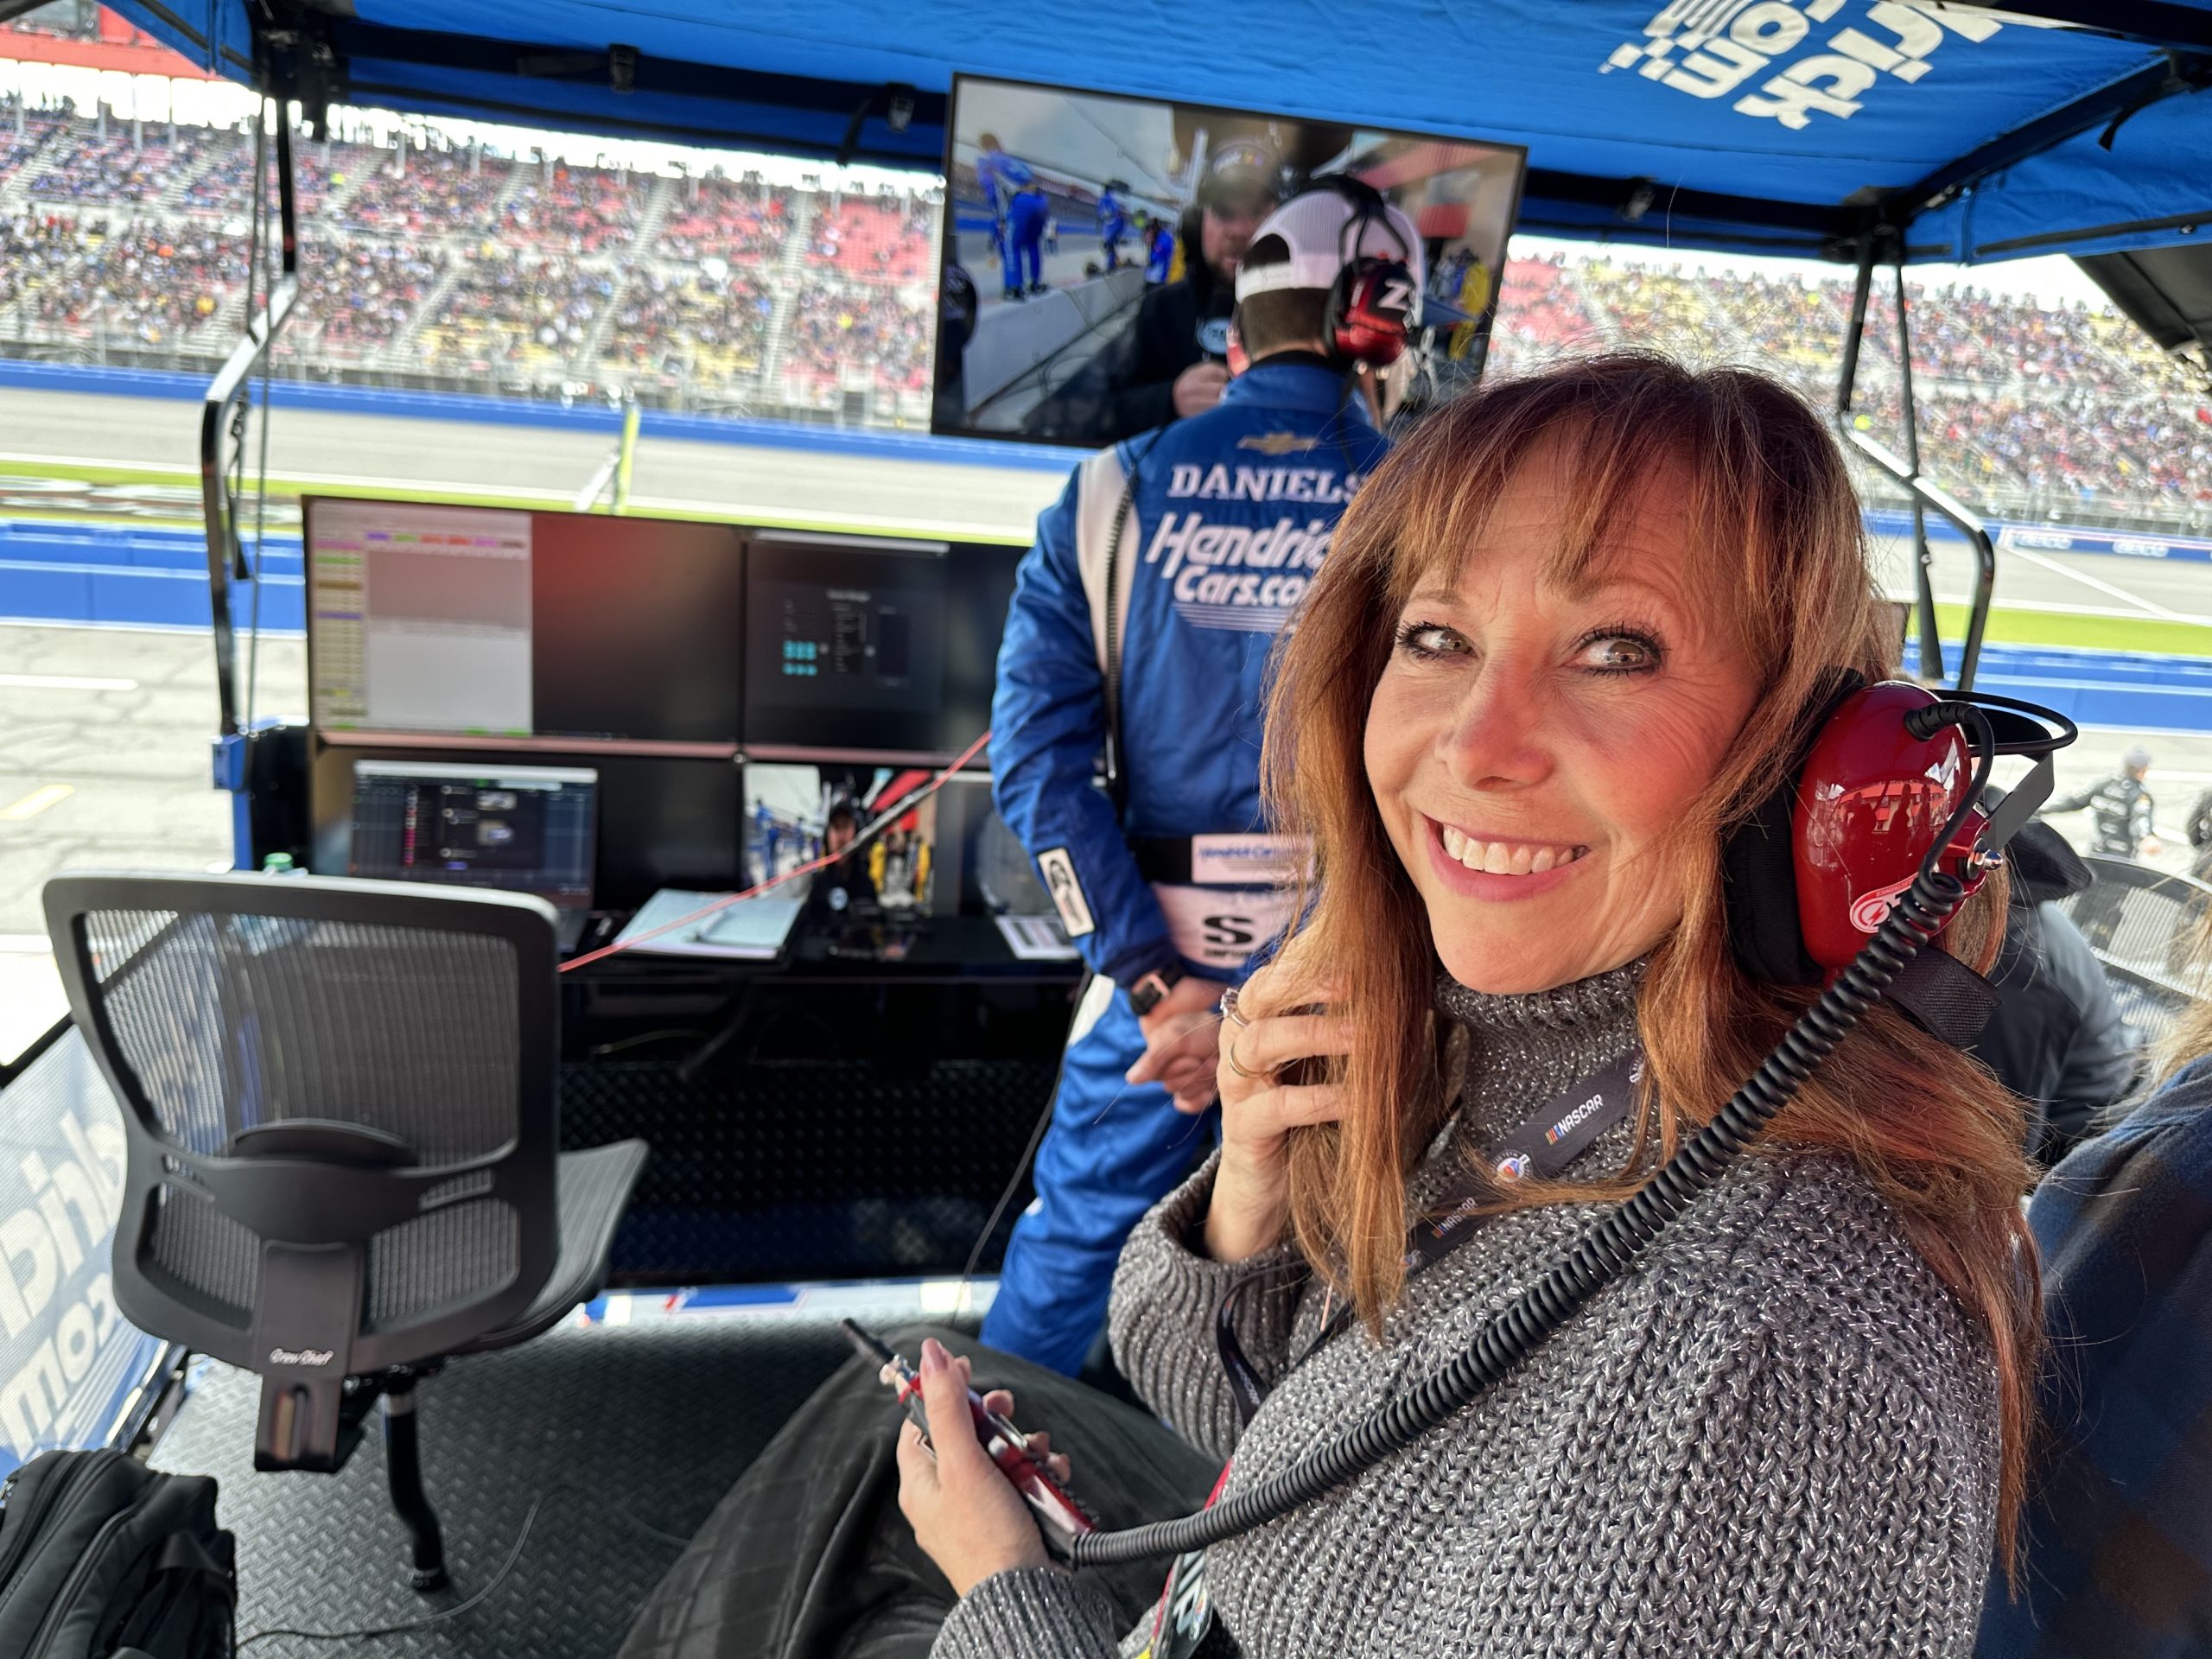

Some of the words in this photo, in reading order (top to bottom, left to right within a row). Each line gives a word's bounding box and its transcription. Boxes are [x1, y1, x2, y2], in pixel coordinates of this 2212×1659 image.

[1732, 0, 2005, 130] rick
[1145, 512, 1334, 580] Hendric
[1173, 563, 1307, 606] Cars.co
[1203, 915, 1255, 945] S
[1555, 1093, 1605, 1136] NASCAR
[1440, 1197, 1478, 1231] NASCAR
